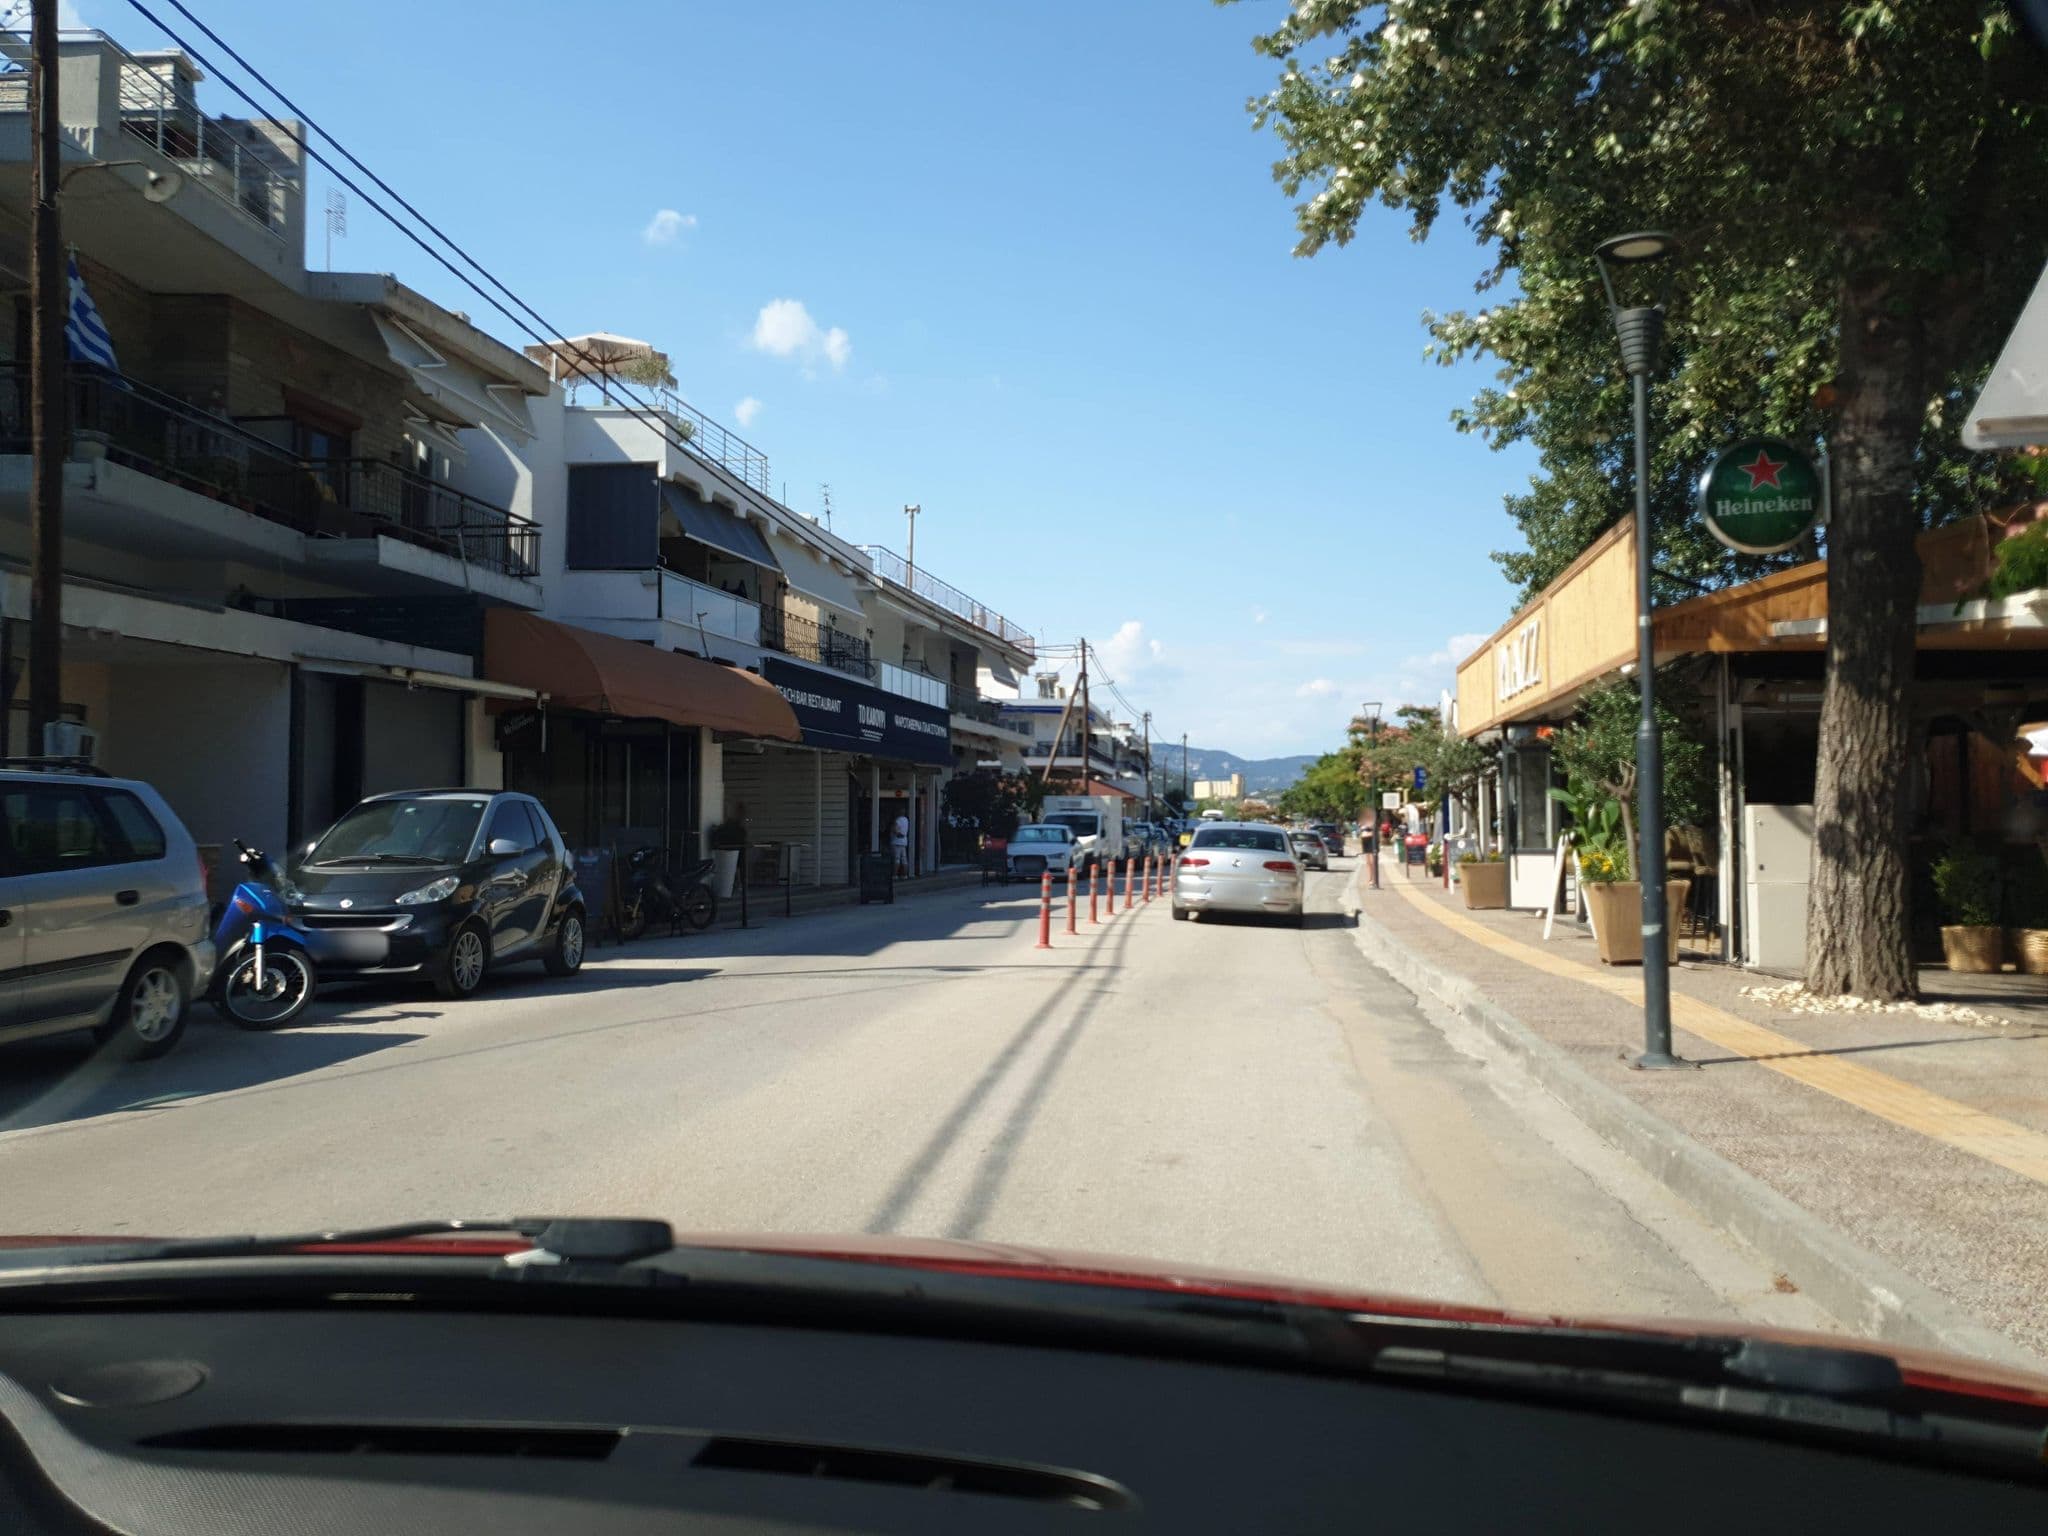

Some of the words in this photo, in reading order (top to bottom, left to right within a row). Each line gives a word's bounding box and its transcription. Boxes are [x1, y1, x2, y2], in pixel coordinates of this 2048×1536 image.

[1715, 496, 1814, 517] Heineken
[796, 690, 807, 706] BAR
[808, 693, 841, 713] RESTAURANT
